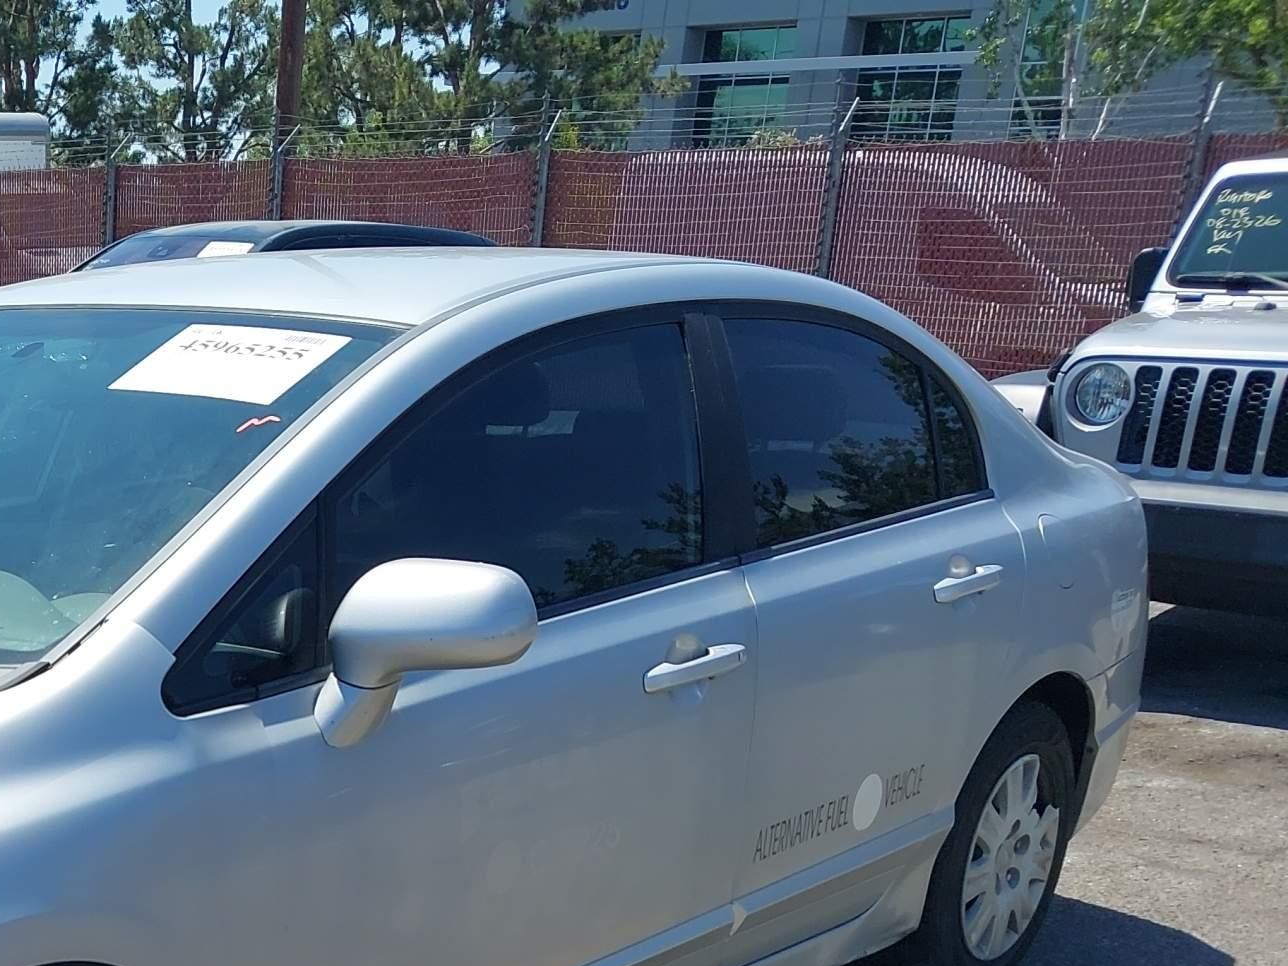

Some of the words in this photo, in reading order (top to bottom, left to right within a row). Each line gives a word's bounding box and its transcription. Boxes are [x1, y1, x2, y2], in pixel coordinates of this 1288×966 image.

[179, 339, 310, 361] 45965255
[752, 804, 825, 863] ALTERNATIVE
[825, 795, 850, 833] FUEL
[884, 763, 926, 809] VEHICLE
